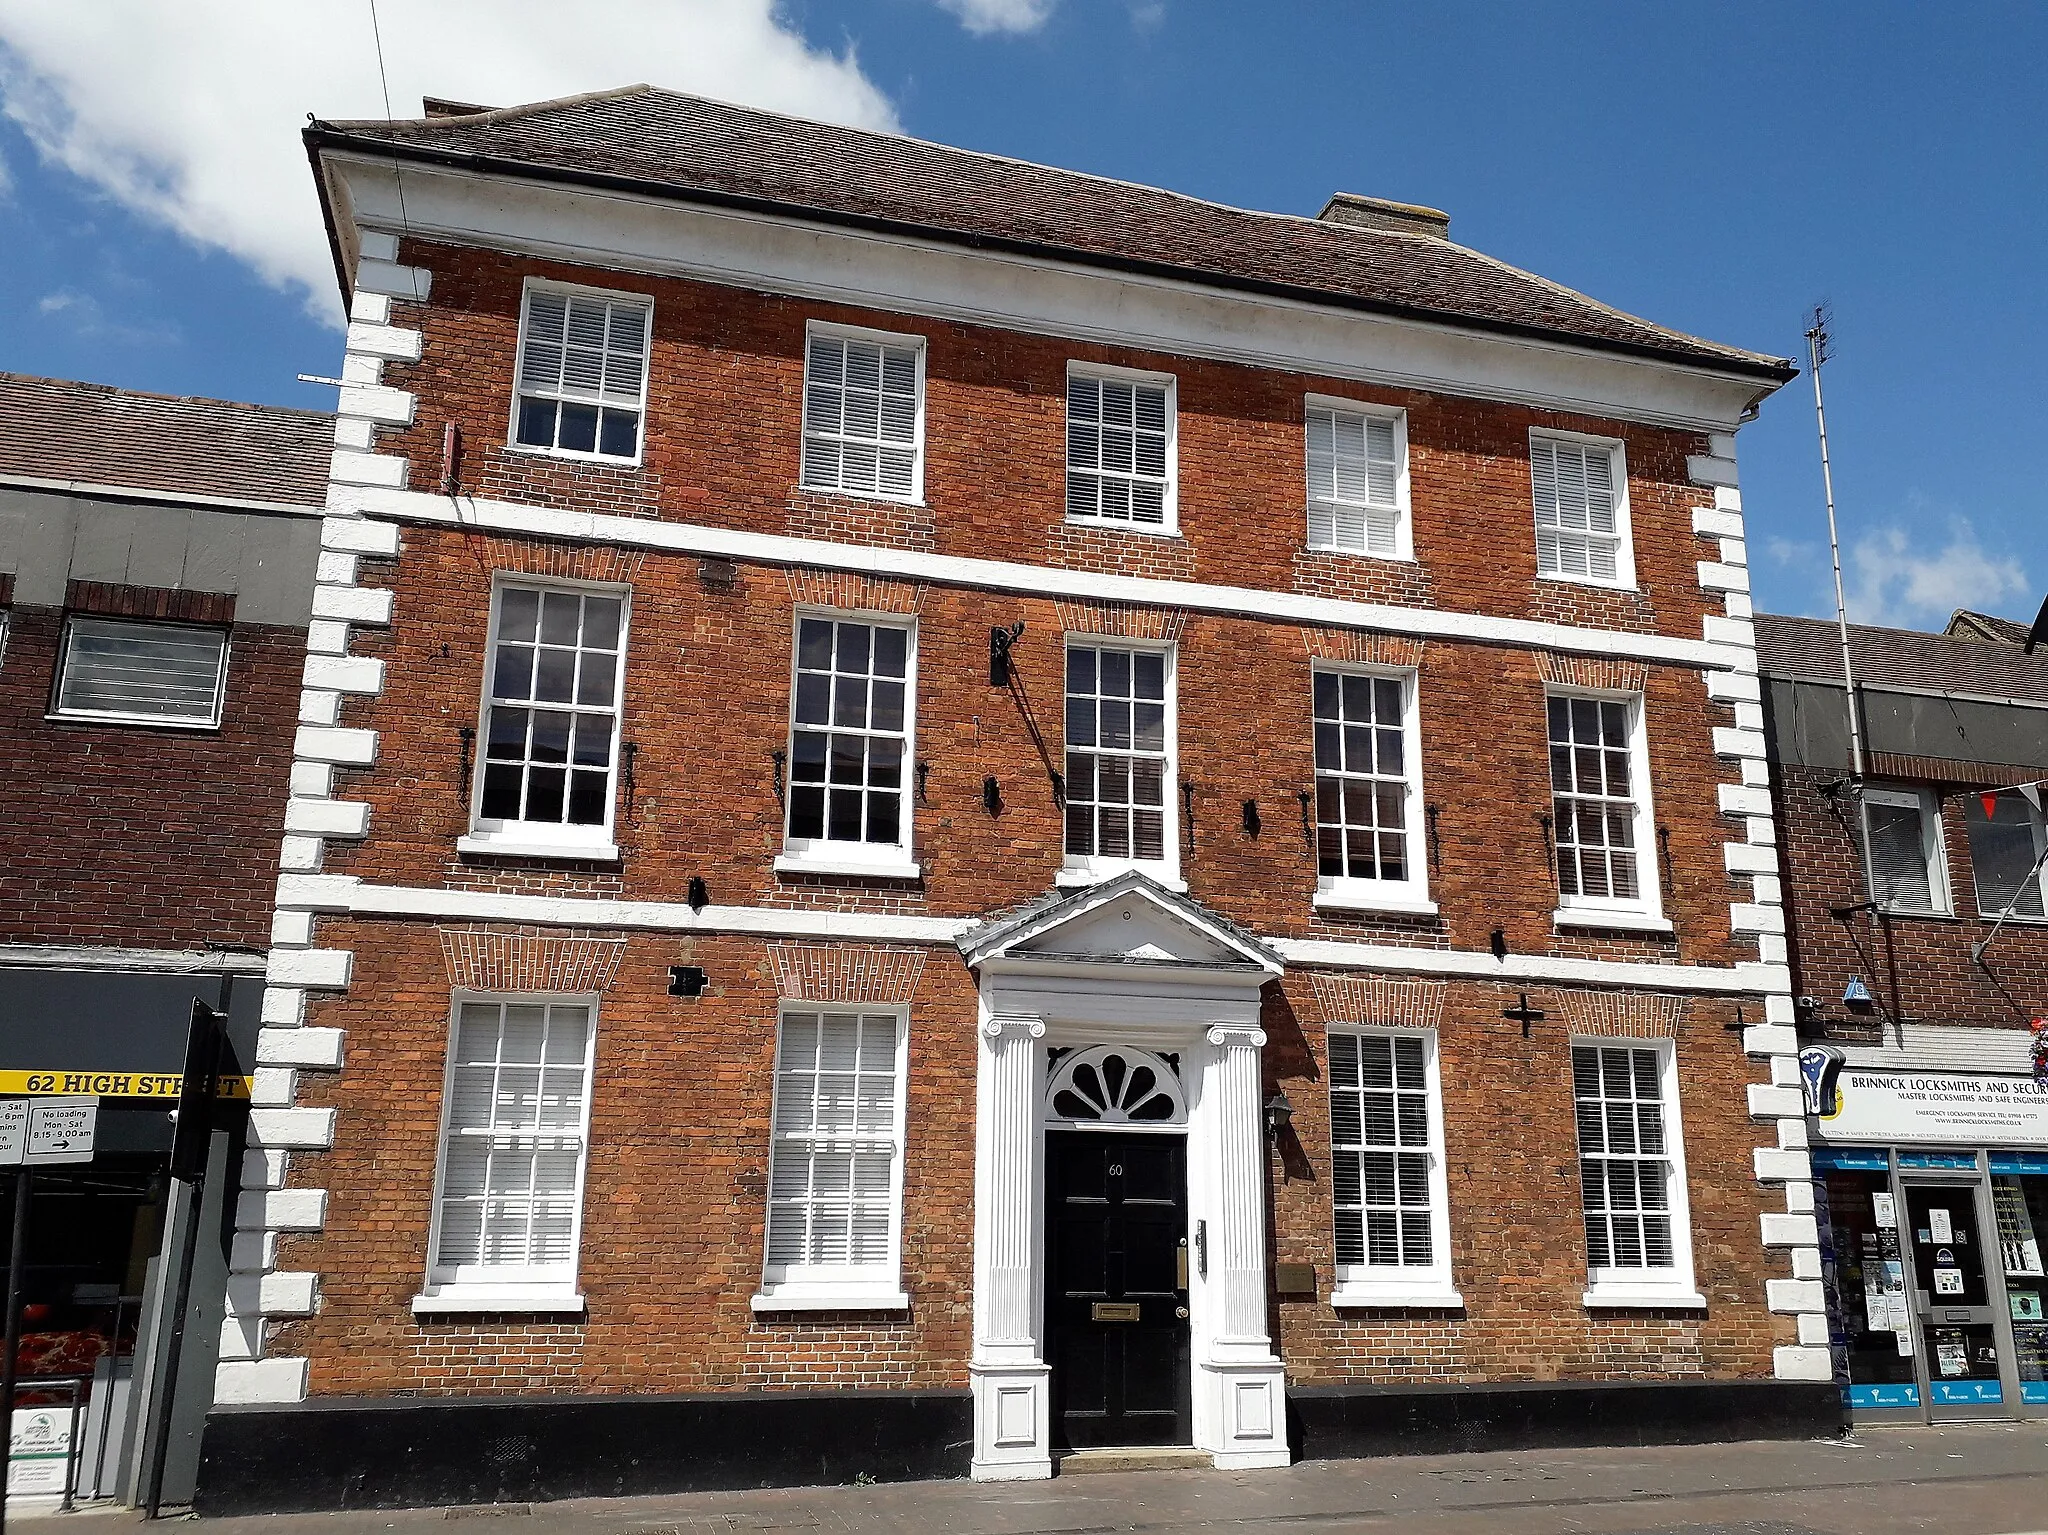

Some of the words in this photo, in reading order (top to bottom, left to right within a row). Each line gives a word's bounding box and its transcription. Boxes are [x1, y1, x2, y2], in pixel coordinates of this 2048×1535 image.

[26, 1075, 55, 1092] 62
[62, 1074, 130, 1094] HIGH
[1851, 1077, 1906, 1090] BRINNICK
[1909, 1079, 1982, 1093] LOCKSMITHS
[1985, 1082, 2009, 1094] AND
[1897, 1092, 1927, 1101] MASTER
[1929, 1094, 1975, 1103] LOCKSMITHS
[1977, 1095, 1993, 1103] AND
[1995, 1095, 2011, 1104] SAFE
[5, 1112, 10, 1120] 6
[56, 1110, 87, 1119] loading
[68, 1120, 83, 1128] Sat
[33, 1131, 51, 1139] 8.15
[57, 1130, 78, 1138] 9.00
[1109, 1164, 1123, 1176] 60
